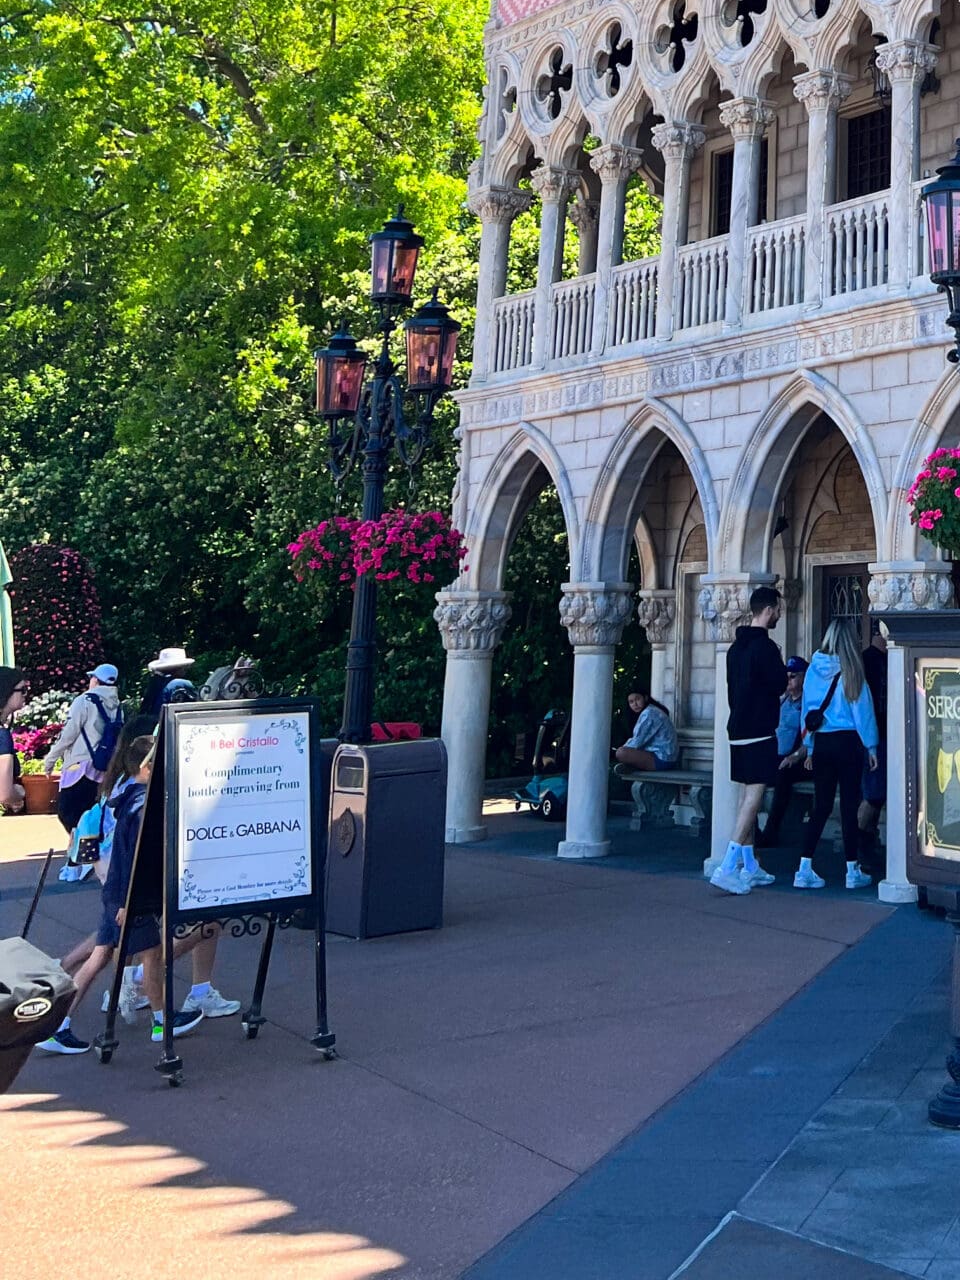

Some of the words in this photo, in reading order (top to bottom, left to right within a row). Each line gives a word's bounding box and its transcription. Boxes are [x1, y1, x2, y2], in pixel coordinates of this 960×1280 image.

[219, 738, 235, 749] Bel
[237, 736, 279, 748] Cristallo
[204, 764, 283, 780] Complimentary
[187, 785, 218, 798] bottle
[220, 781, 273, 798] engraving
[275, 779, 300, 791] from
[186, 826, 228, 841] DOLCE
[229, 830, 235, 838] &
[236, 819, 302, 837] GABBANA
